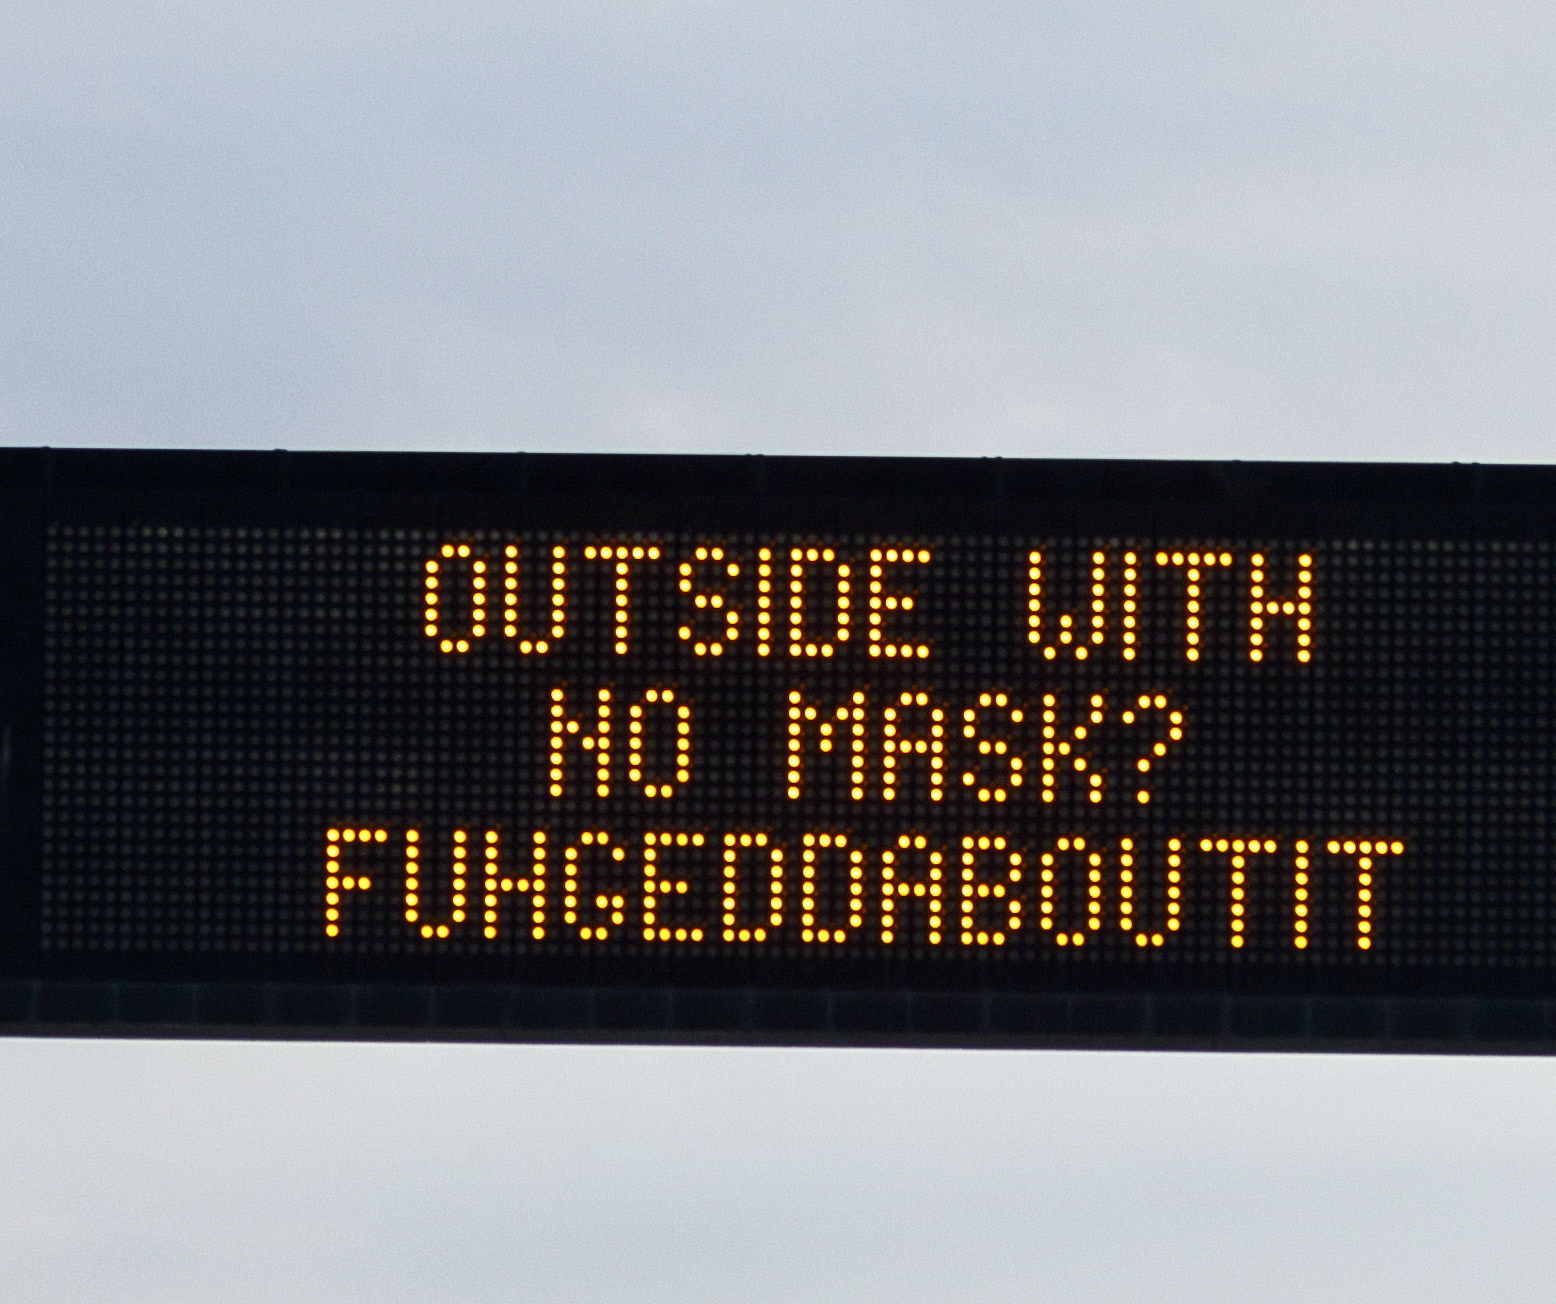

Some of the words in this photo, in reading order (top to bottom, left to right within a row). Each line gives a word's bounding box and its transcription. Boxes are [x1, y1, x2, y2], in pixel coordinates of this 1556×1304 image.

[421, 542, 934, 661] OUTSIDE
[1025, 548, 1316, 665] WITH
[546, 686, 693, 801] NO
[784, 688, 1186, 807] MASK?
[323, 825, 1407, 952] FUHGEDDABOUTIT
